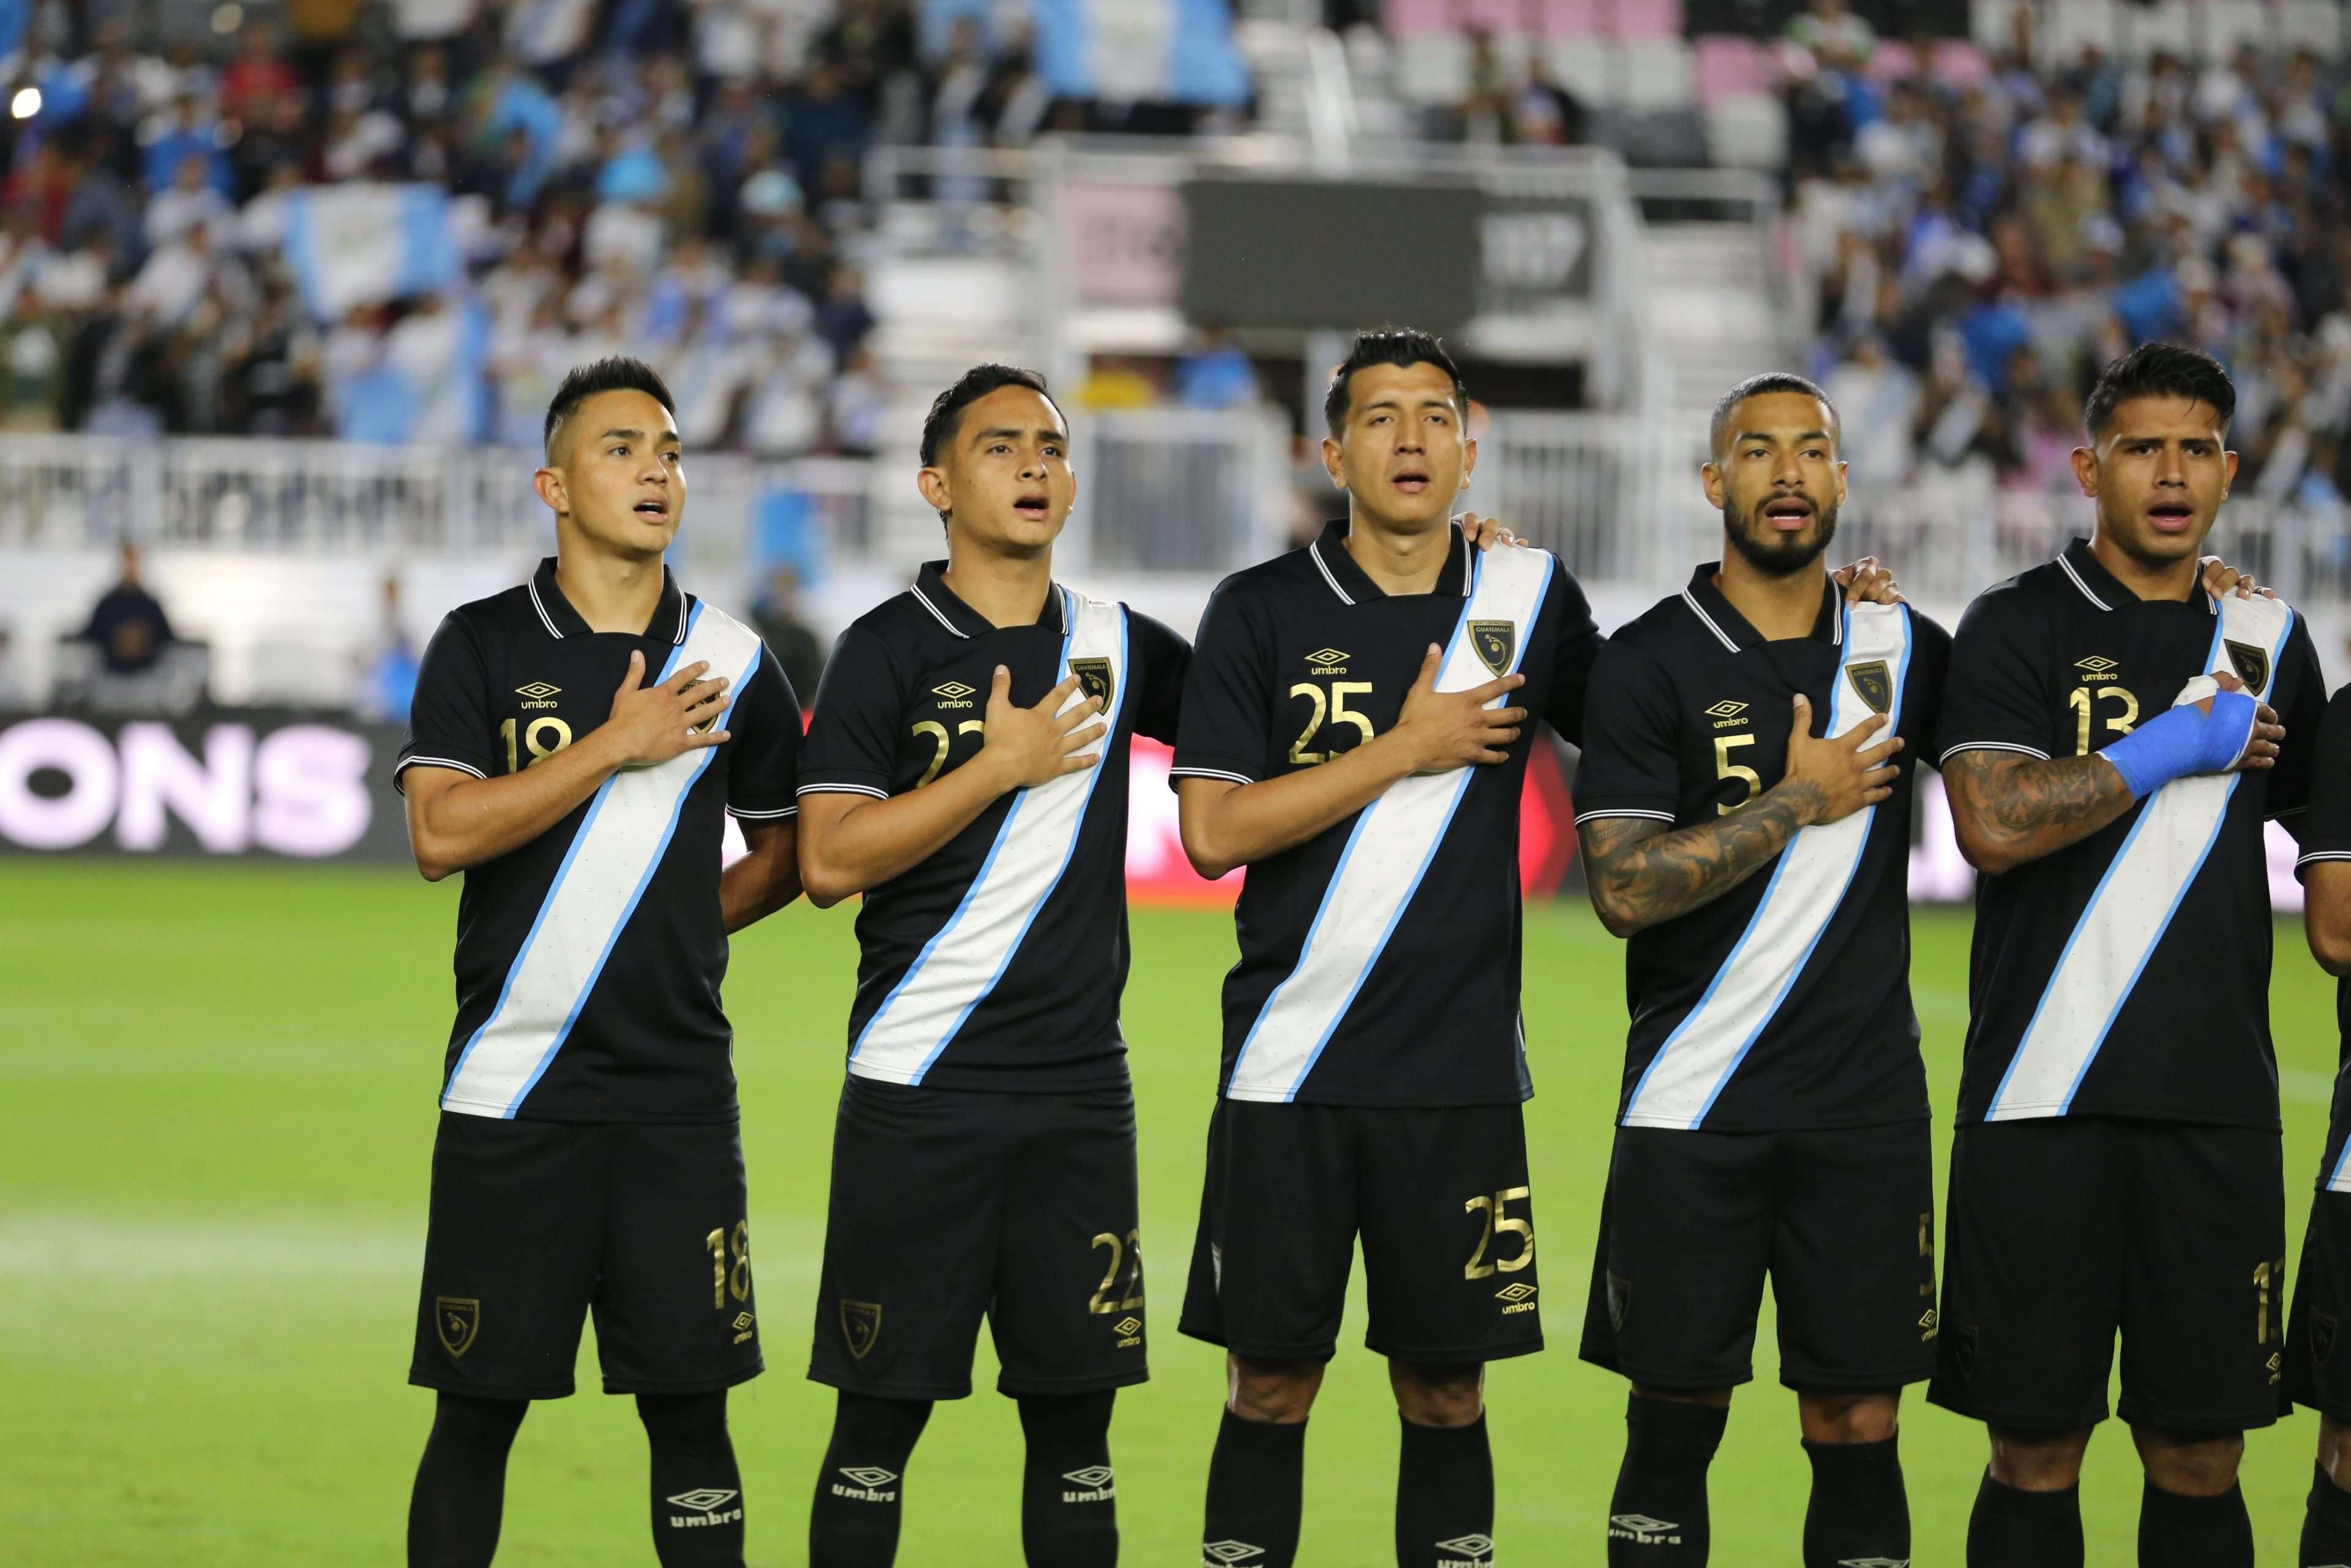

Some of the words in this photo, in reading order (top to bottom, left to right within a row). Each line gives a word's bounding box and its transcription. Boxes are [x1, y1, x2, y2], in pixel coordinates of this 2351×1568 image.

[1311, 665, 1347, 675] umbro
[2082, 672, 2118, 682] umbro
[521, 699, 558, 710] umbro
[937, 699, 973, 709] umbro
[1289, 681, 1374, 764] 25
[1713, 716, 1749, 729] umbro
[2070, 686, 2139, 757] 13
[500, 716, 572, 773] 18
[0, 717, 372, 857] ONS
[1714, 733, 1761, 816] 5
[1465, 1185, 1534, 1280] 25
[707, 1219, 749, 1310] 18
[1089, 1228, 1144, 1315] 22
[1502, 1302, 1535, 1315] umbro
[2254, 1256, 2285, 1344] 1
[831, 1484, 896, 1502] umbro
[1062, 1486, 1117, 1502] umbr
[670, 1508, 742, 1528] umbro
